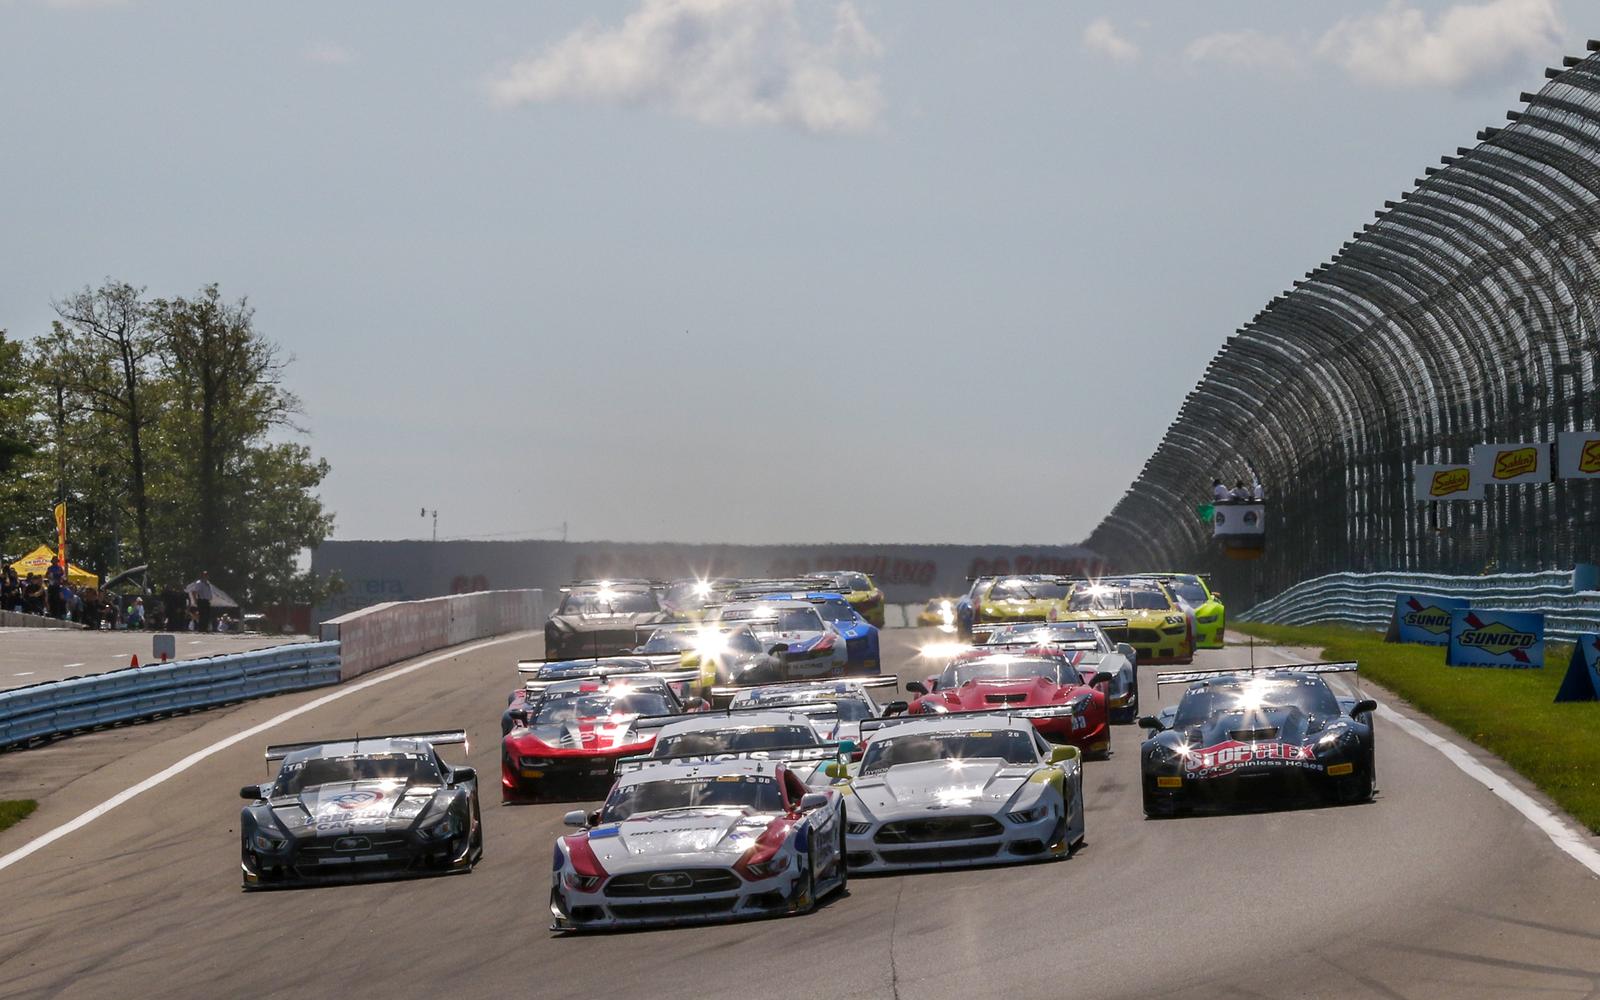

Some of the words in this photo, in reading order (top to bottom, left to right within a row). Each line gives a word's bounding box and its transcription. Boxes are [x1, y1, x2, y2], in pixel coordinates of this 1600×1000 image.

[1407, 614, 1452, 626] SUNOC
[1462, 633, 1533, 647] SUNOCO
[878, 740, 893, 748] TA
[289, 762, 303, 772] TA
[619, 786, 635, 794] TA
